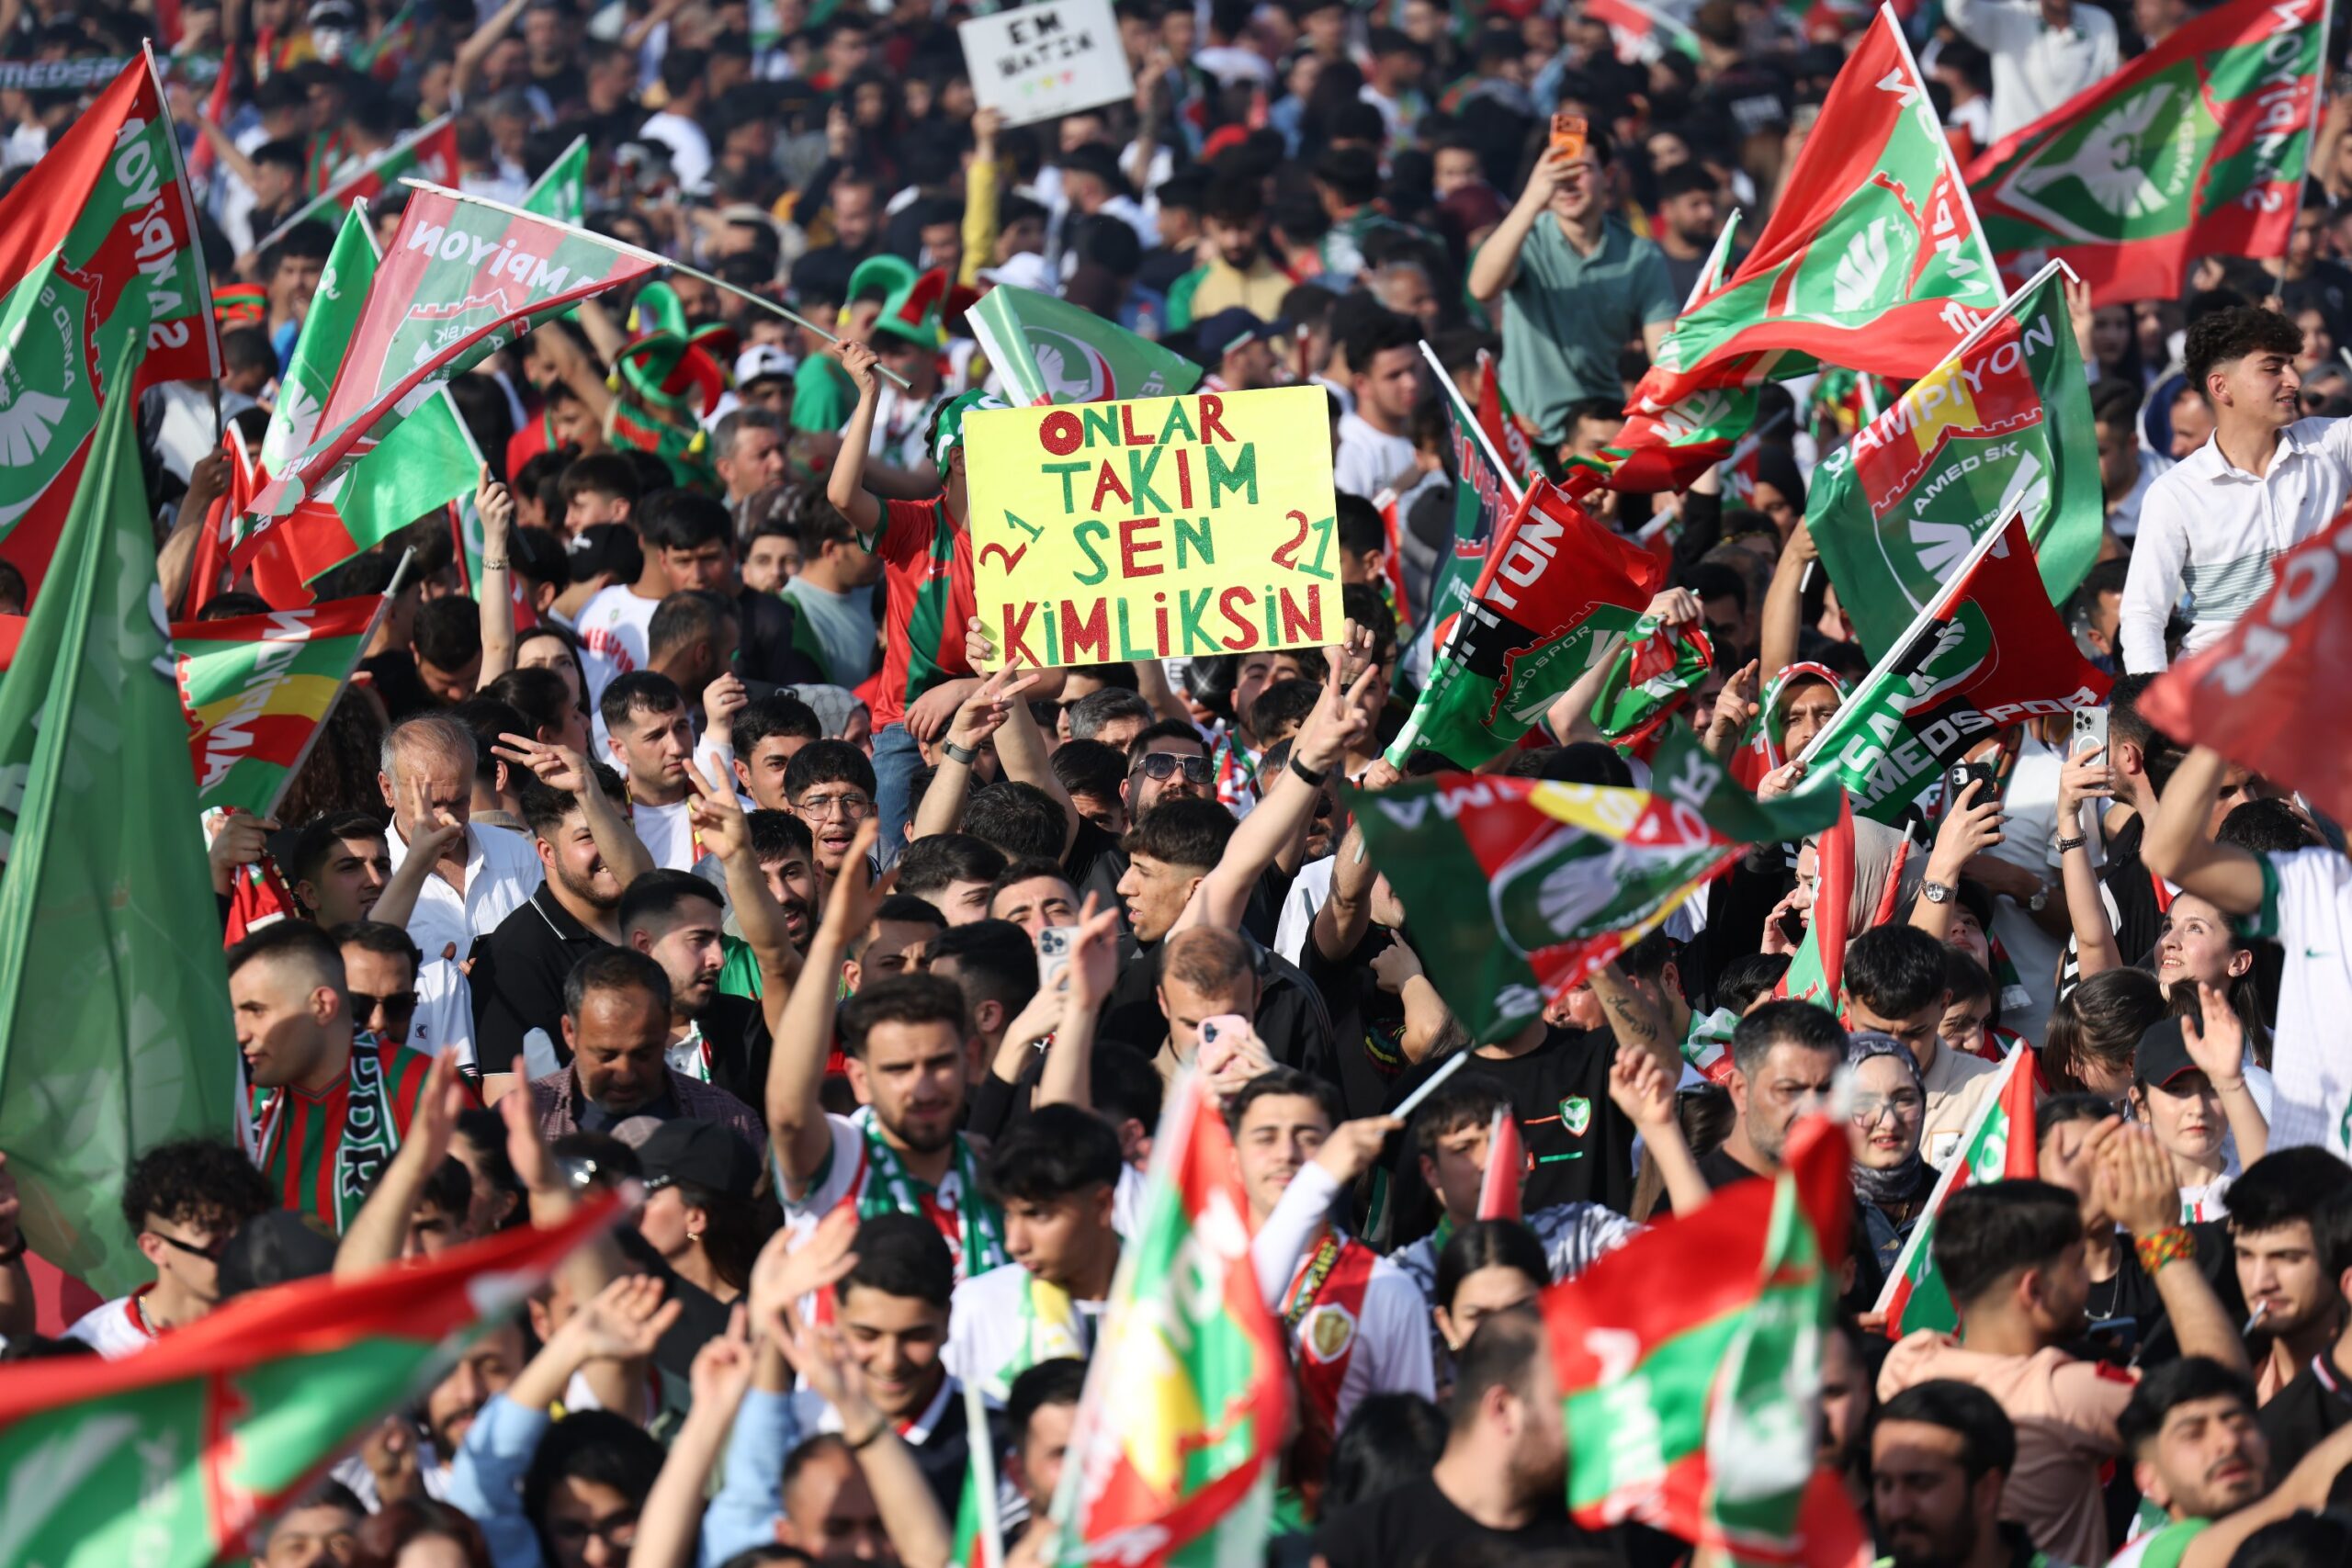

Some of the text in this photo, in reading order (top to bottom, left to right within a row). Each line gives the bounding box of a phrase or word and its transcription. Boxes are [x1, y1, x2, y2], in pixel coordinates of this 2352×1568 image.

[1039, 394, 1236, 456] ONLAR
[1042, 442, 1259, 515] TAKIM
[1914, 441, 2018, 516] AMED SK
[978, 509, 1045, 576] 21
[1073, 516, 1215, 586] SEN
[1272, 509, 1336, 581] 21
[1503, 626, 1591, 713] AMEDSPOR
[1845, 685, 2098, 817] AMEDSPOR
